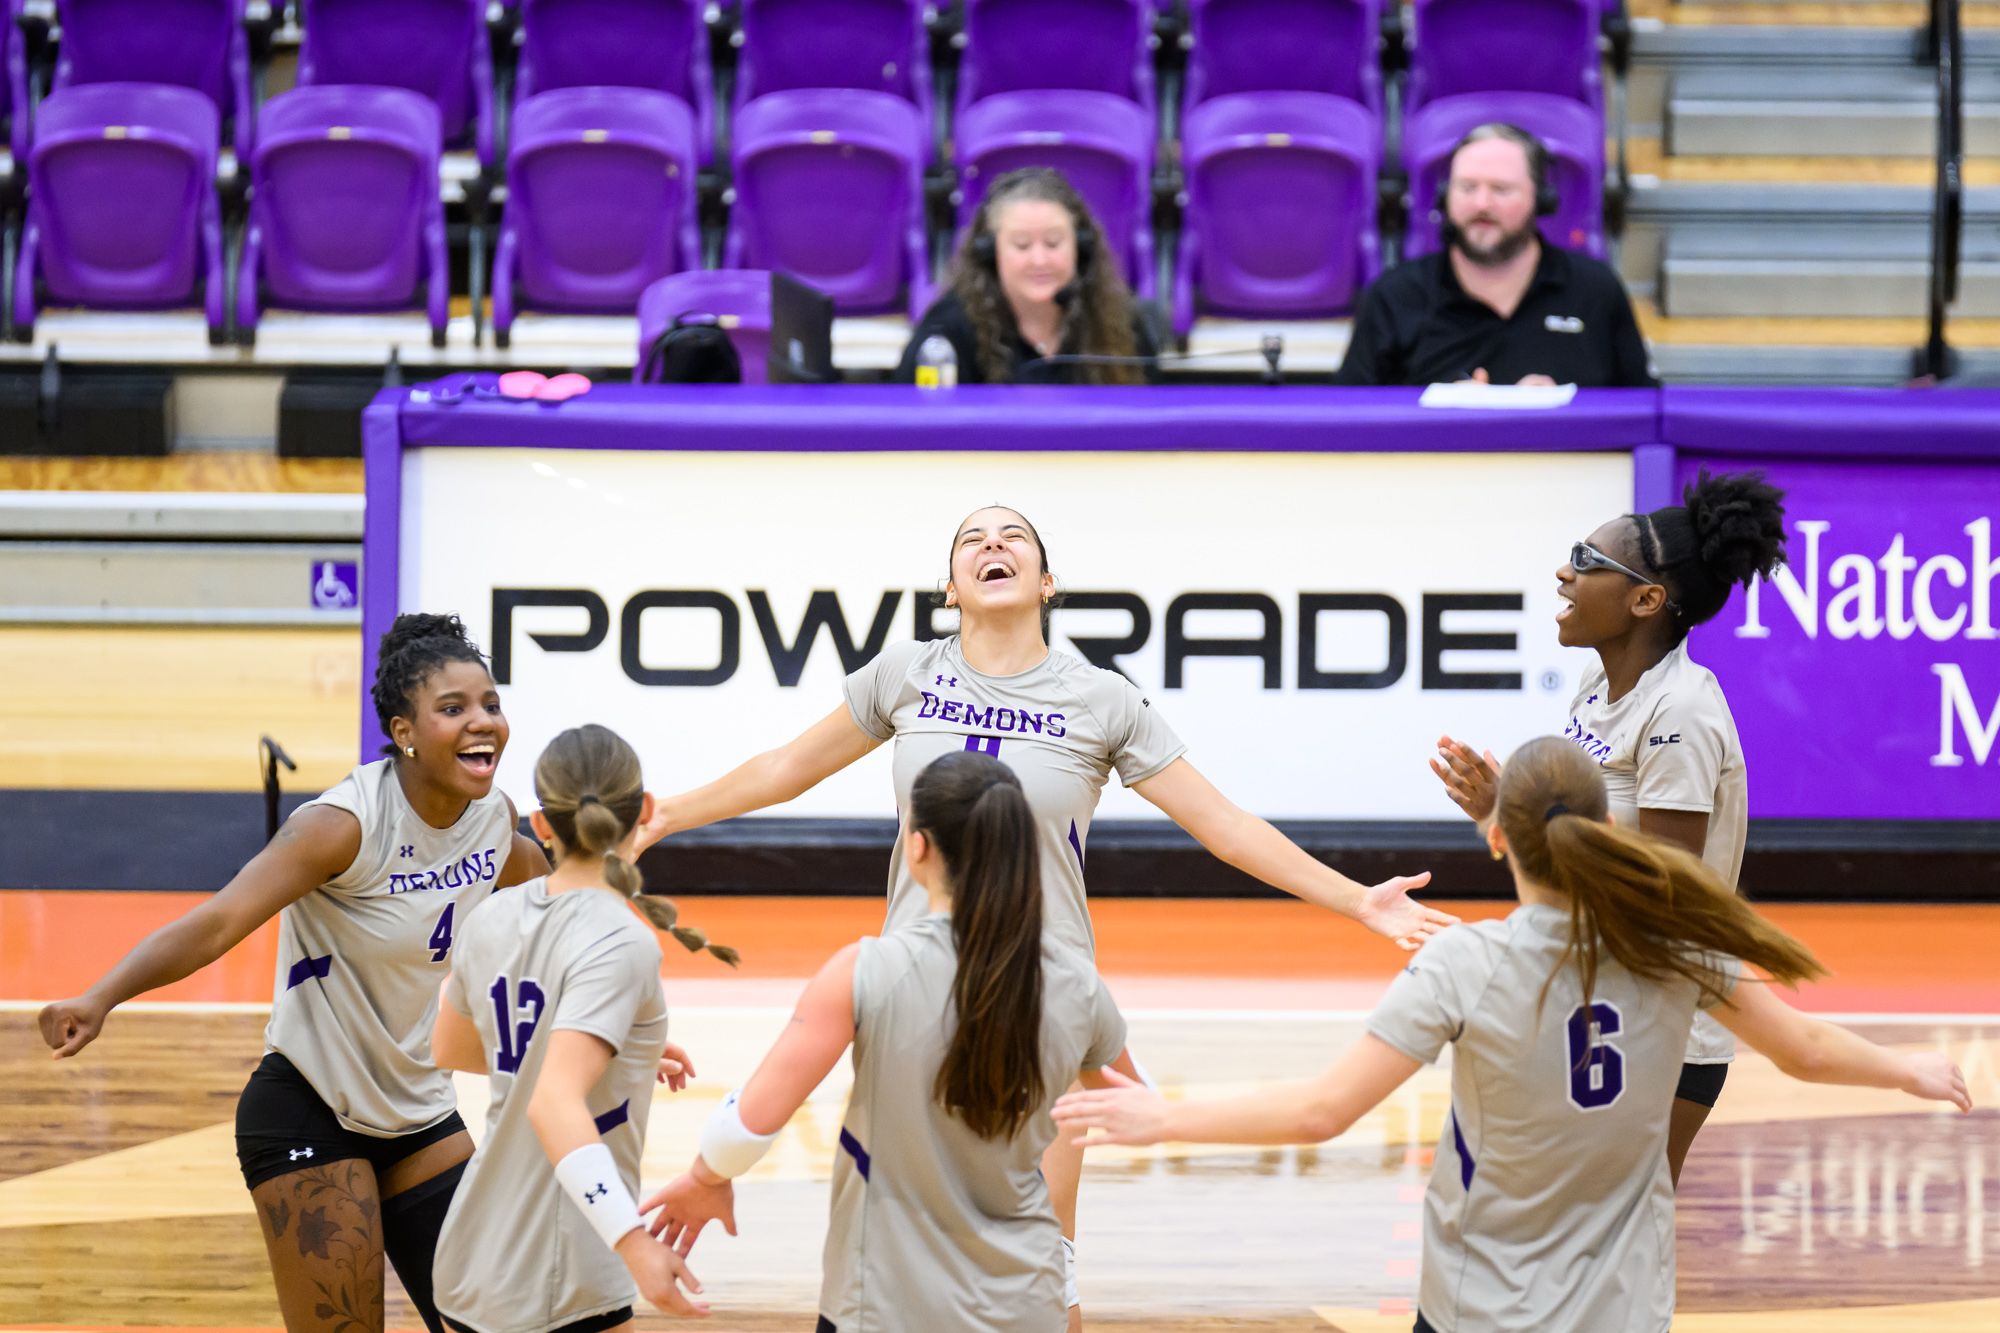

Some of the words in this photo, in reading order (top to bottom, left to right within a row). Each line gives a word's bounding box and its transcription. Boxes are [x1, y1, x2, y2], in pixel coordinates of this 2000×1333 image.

[917, 690, 1067, 738] DEMONS
[1649, 733, 1681, 747] SLC
[427, 901, 456, 963] 4
[487, 973, 546, 1077] 12
[1564, 999, 1627, 1113] 6
